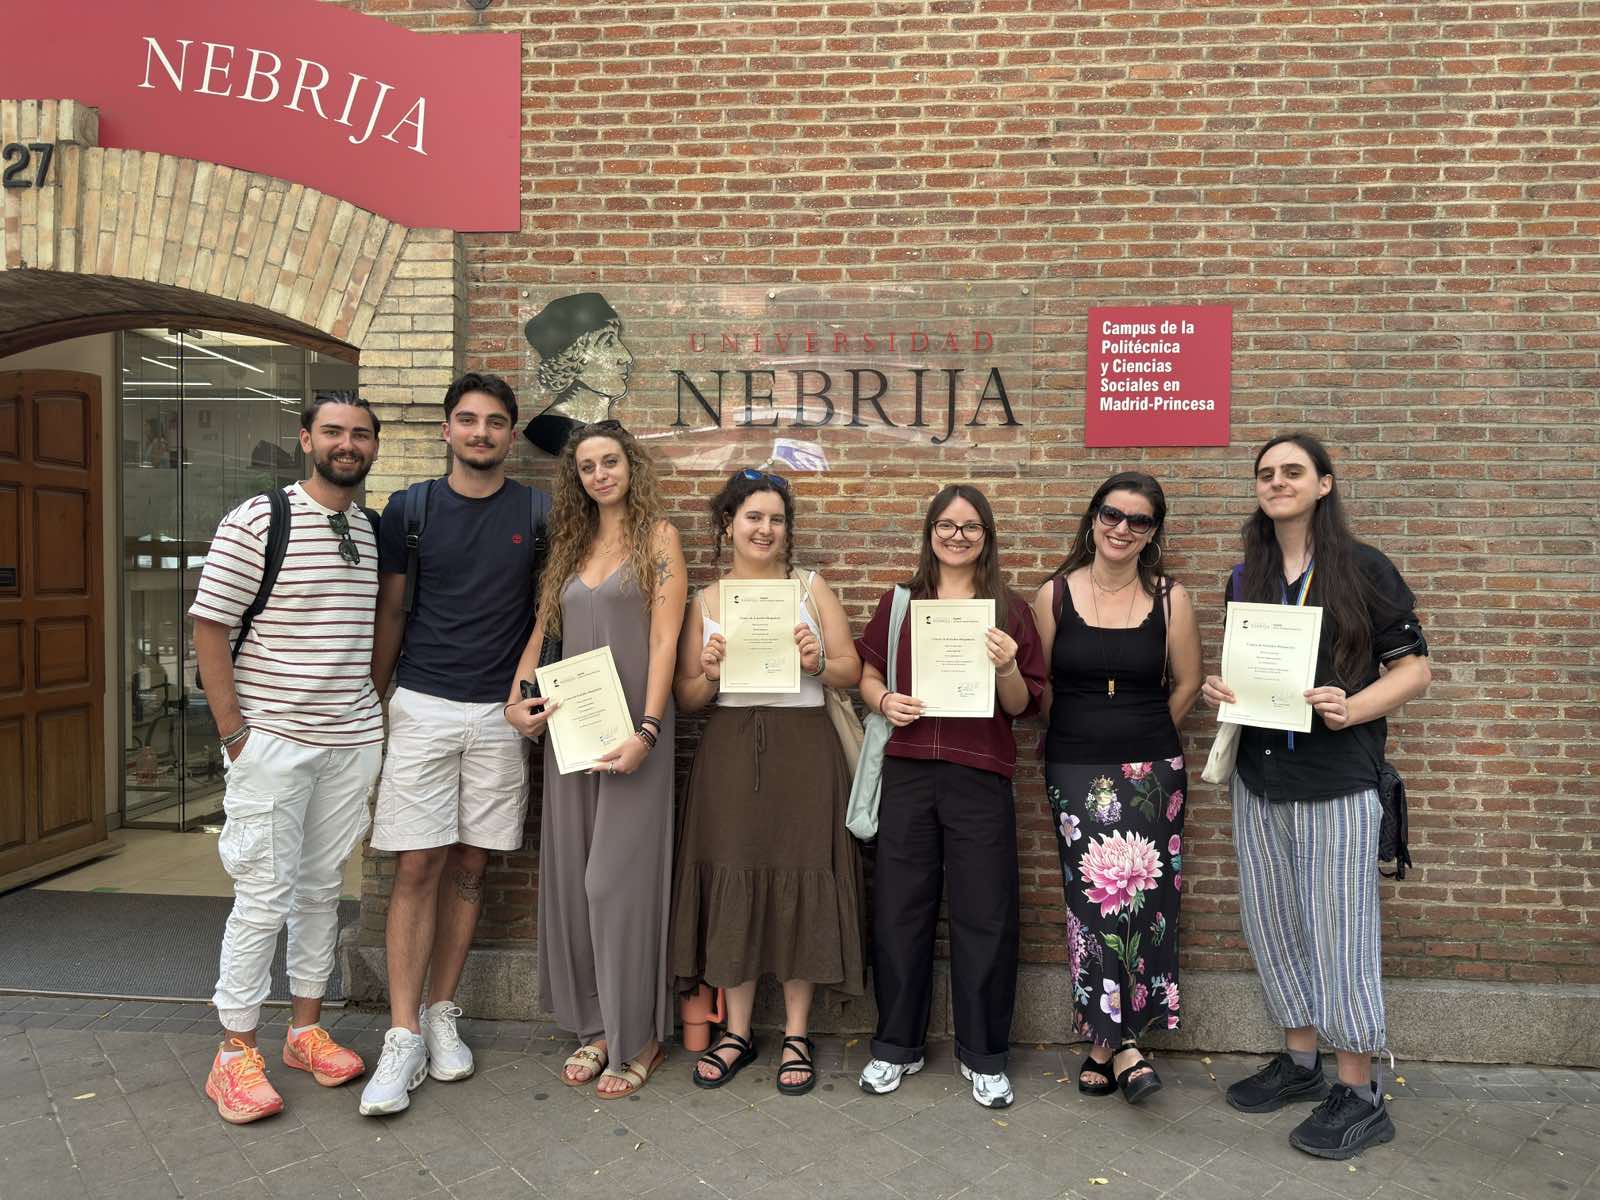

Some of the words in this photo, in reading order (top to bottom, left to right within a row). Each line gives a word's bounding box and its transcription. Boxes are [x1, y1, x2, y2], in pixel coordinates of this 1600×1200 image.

[138, 36, 428, 156] NEBRIJA
[2, 143, 54, 188] 27
[1102, 321, 1157, 338] Campus
[1160, 320, 1177, 334] de
[1181, 320, 1194, 334] la
[688, 330, 994, 354] UNIVERSIDAD
[1101, 339, 1180, 354] Politécnica
[1100, 362, 1109, 376] y
[1112, 359, 1172, 373] Ciencias
[1100, 378, 1159, 392] Sociales
[1163, 380, 1180, 391] en
[670, 367, 1023, 445] NEBRIJA
[1100, 397, 1215, 411] Madrid-Princesa
